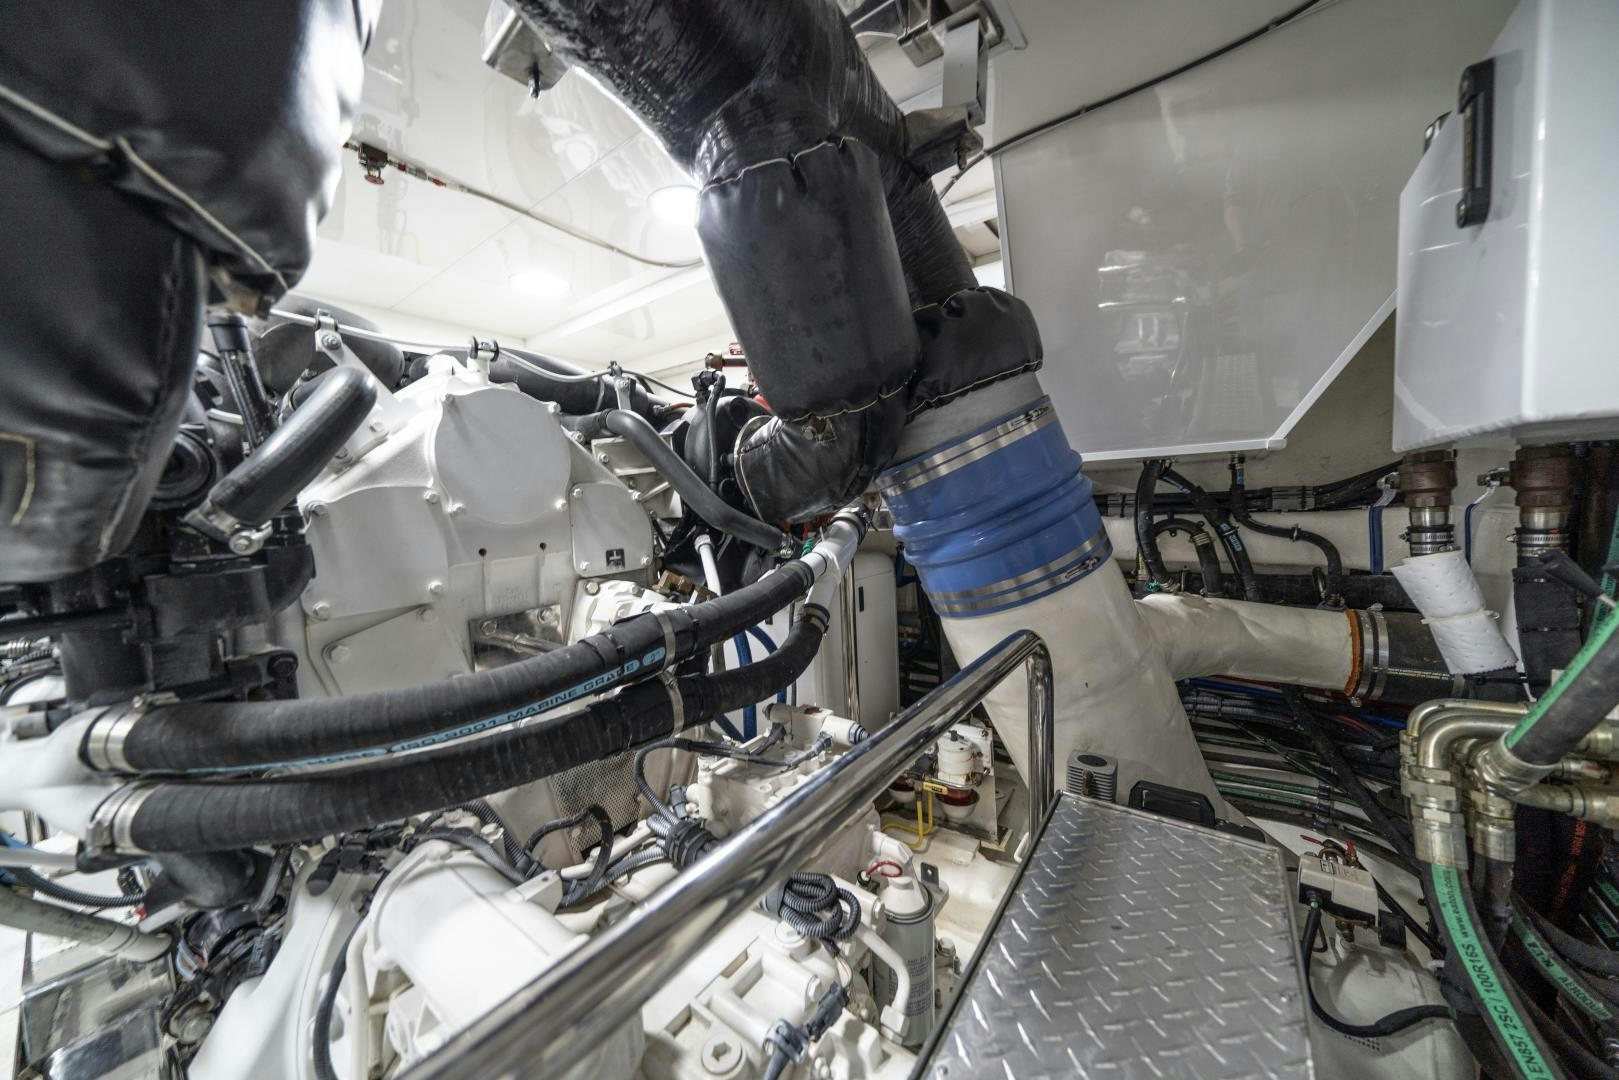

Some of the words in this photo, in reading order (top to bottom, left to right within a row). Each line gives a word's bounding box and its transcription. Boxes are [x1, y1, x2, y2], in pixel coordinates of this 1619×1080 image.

[507, 690, 578, 721] MARINE
[1461, 943, 1497, 994] 100R16S
[1494, 1005, 1518, 1030] 2SC
[1509, 1033, 1543, 1073] EN857
